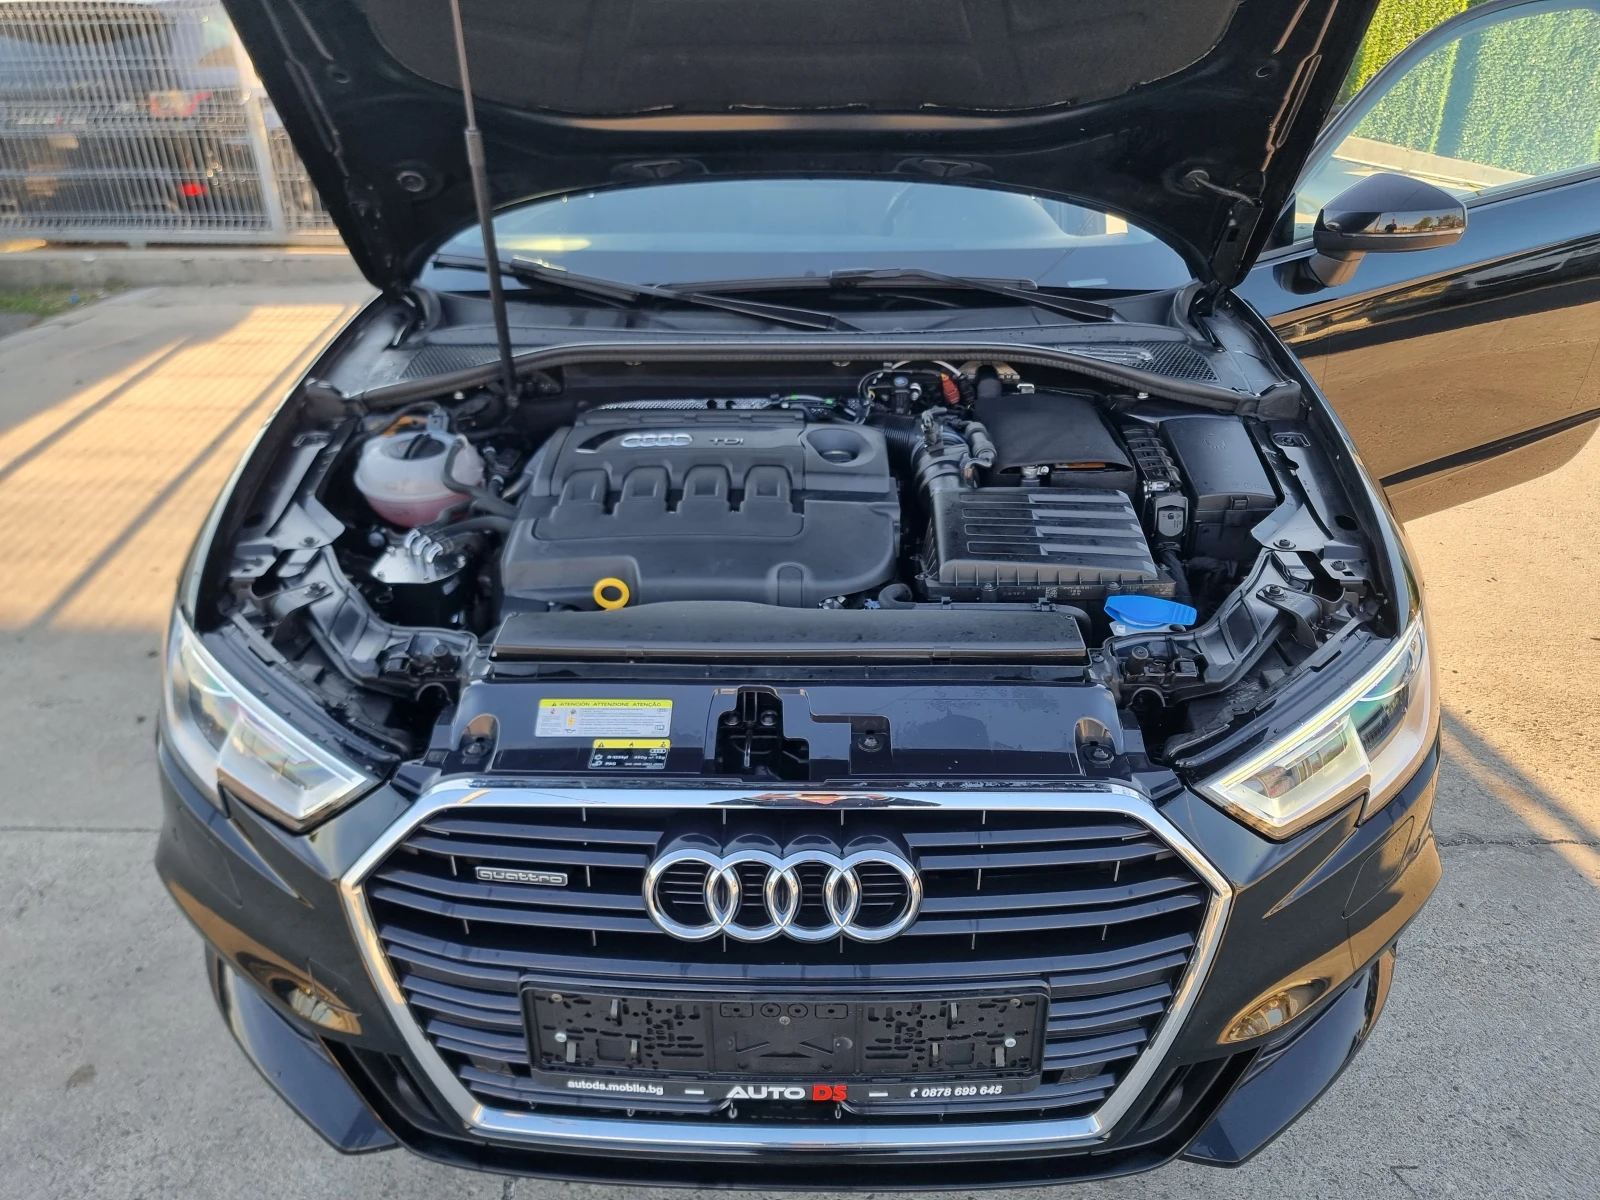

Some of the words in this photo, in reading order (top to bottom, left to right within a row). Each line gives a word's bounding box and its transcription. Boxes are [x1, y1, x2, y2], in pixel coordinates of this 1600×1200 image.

[709, 437, 744, 446] TDI
[479, 870, 563, 883] quattro
[567, 1080, 664, 1096] autods.mobile.bg
[725, 1085, 806, 1100] AUTO
[812, 1084, 848, 1101] DS
[921, 1087, 952, 1098] 0878
[954, 1086, 977, 1096] 699
[979, 1085, 1003, 1095] 645
